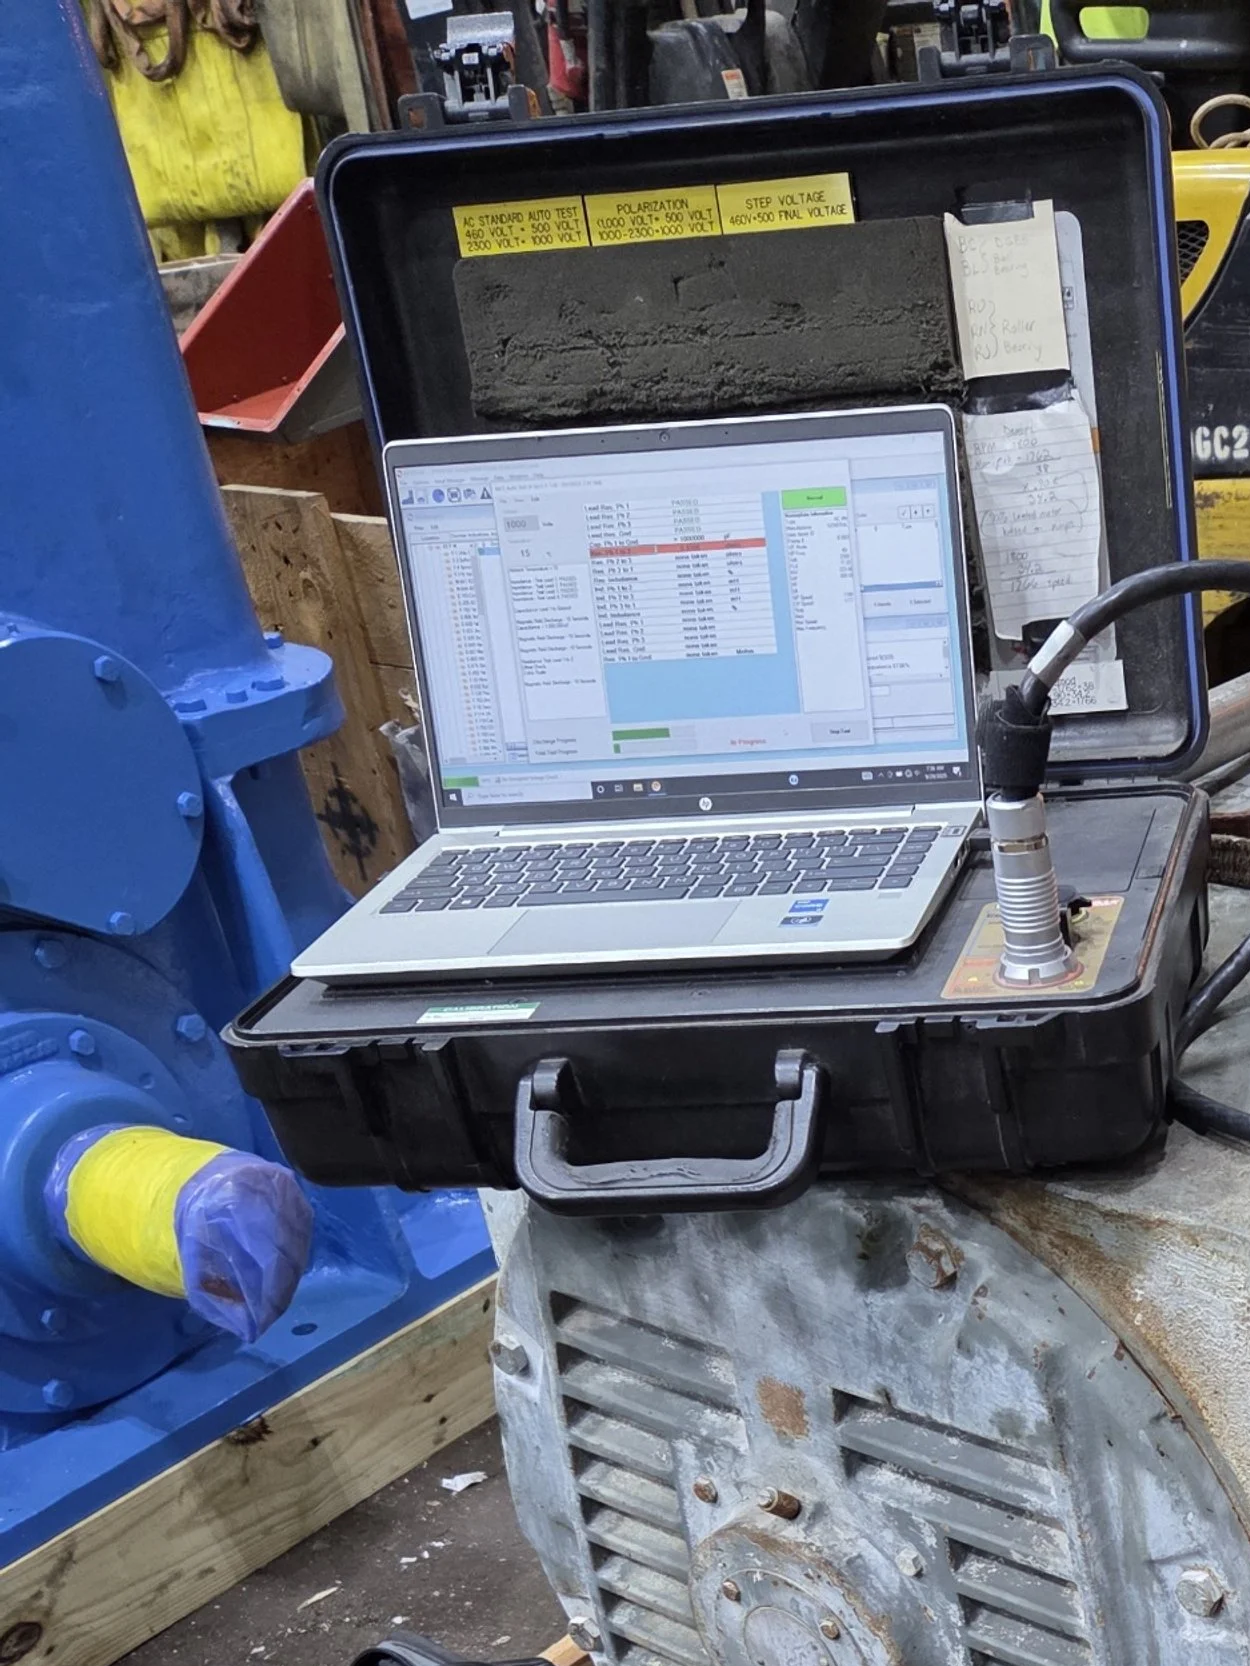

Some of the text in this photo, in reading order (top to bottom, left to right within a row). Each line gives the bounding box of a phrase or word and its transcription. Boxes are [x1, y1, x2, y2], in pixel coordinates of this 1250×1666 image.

[616, 198, 689, 215] POLARIZATION
[745, 190, 827, 210] STEP VOLTAGE
[463, 206, 578, 228] AC STANDARD AUTO TEST
[665, 211, 684, 223] 500
[687, 207, 712, 221] VOLT
[778, 209, 804, 221] FINAL
[806, 203, 849, 218] VOLTAGE
[465, 228, 485, 239] 460
[489, 225, 514, 237] VOLT
[531, 222, 551, 234] 500
[554, 218, 579, 231] VOLT
[688, 220, 714, 233] VOLT
[467, 240, 491, 252] 2300
[531, 234, 553, 247] 1000
[557, 230, 581, 243] VOLT
